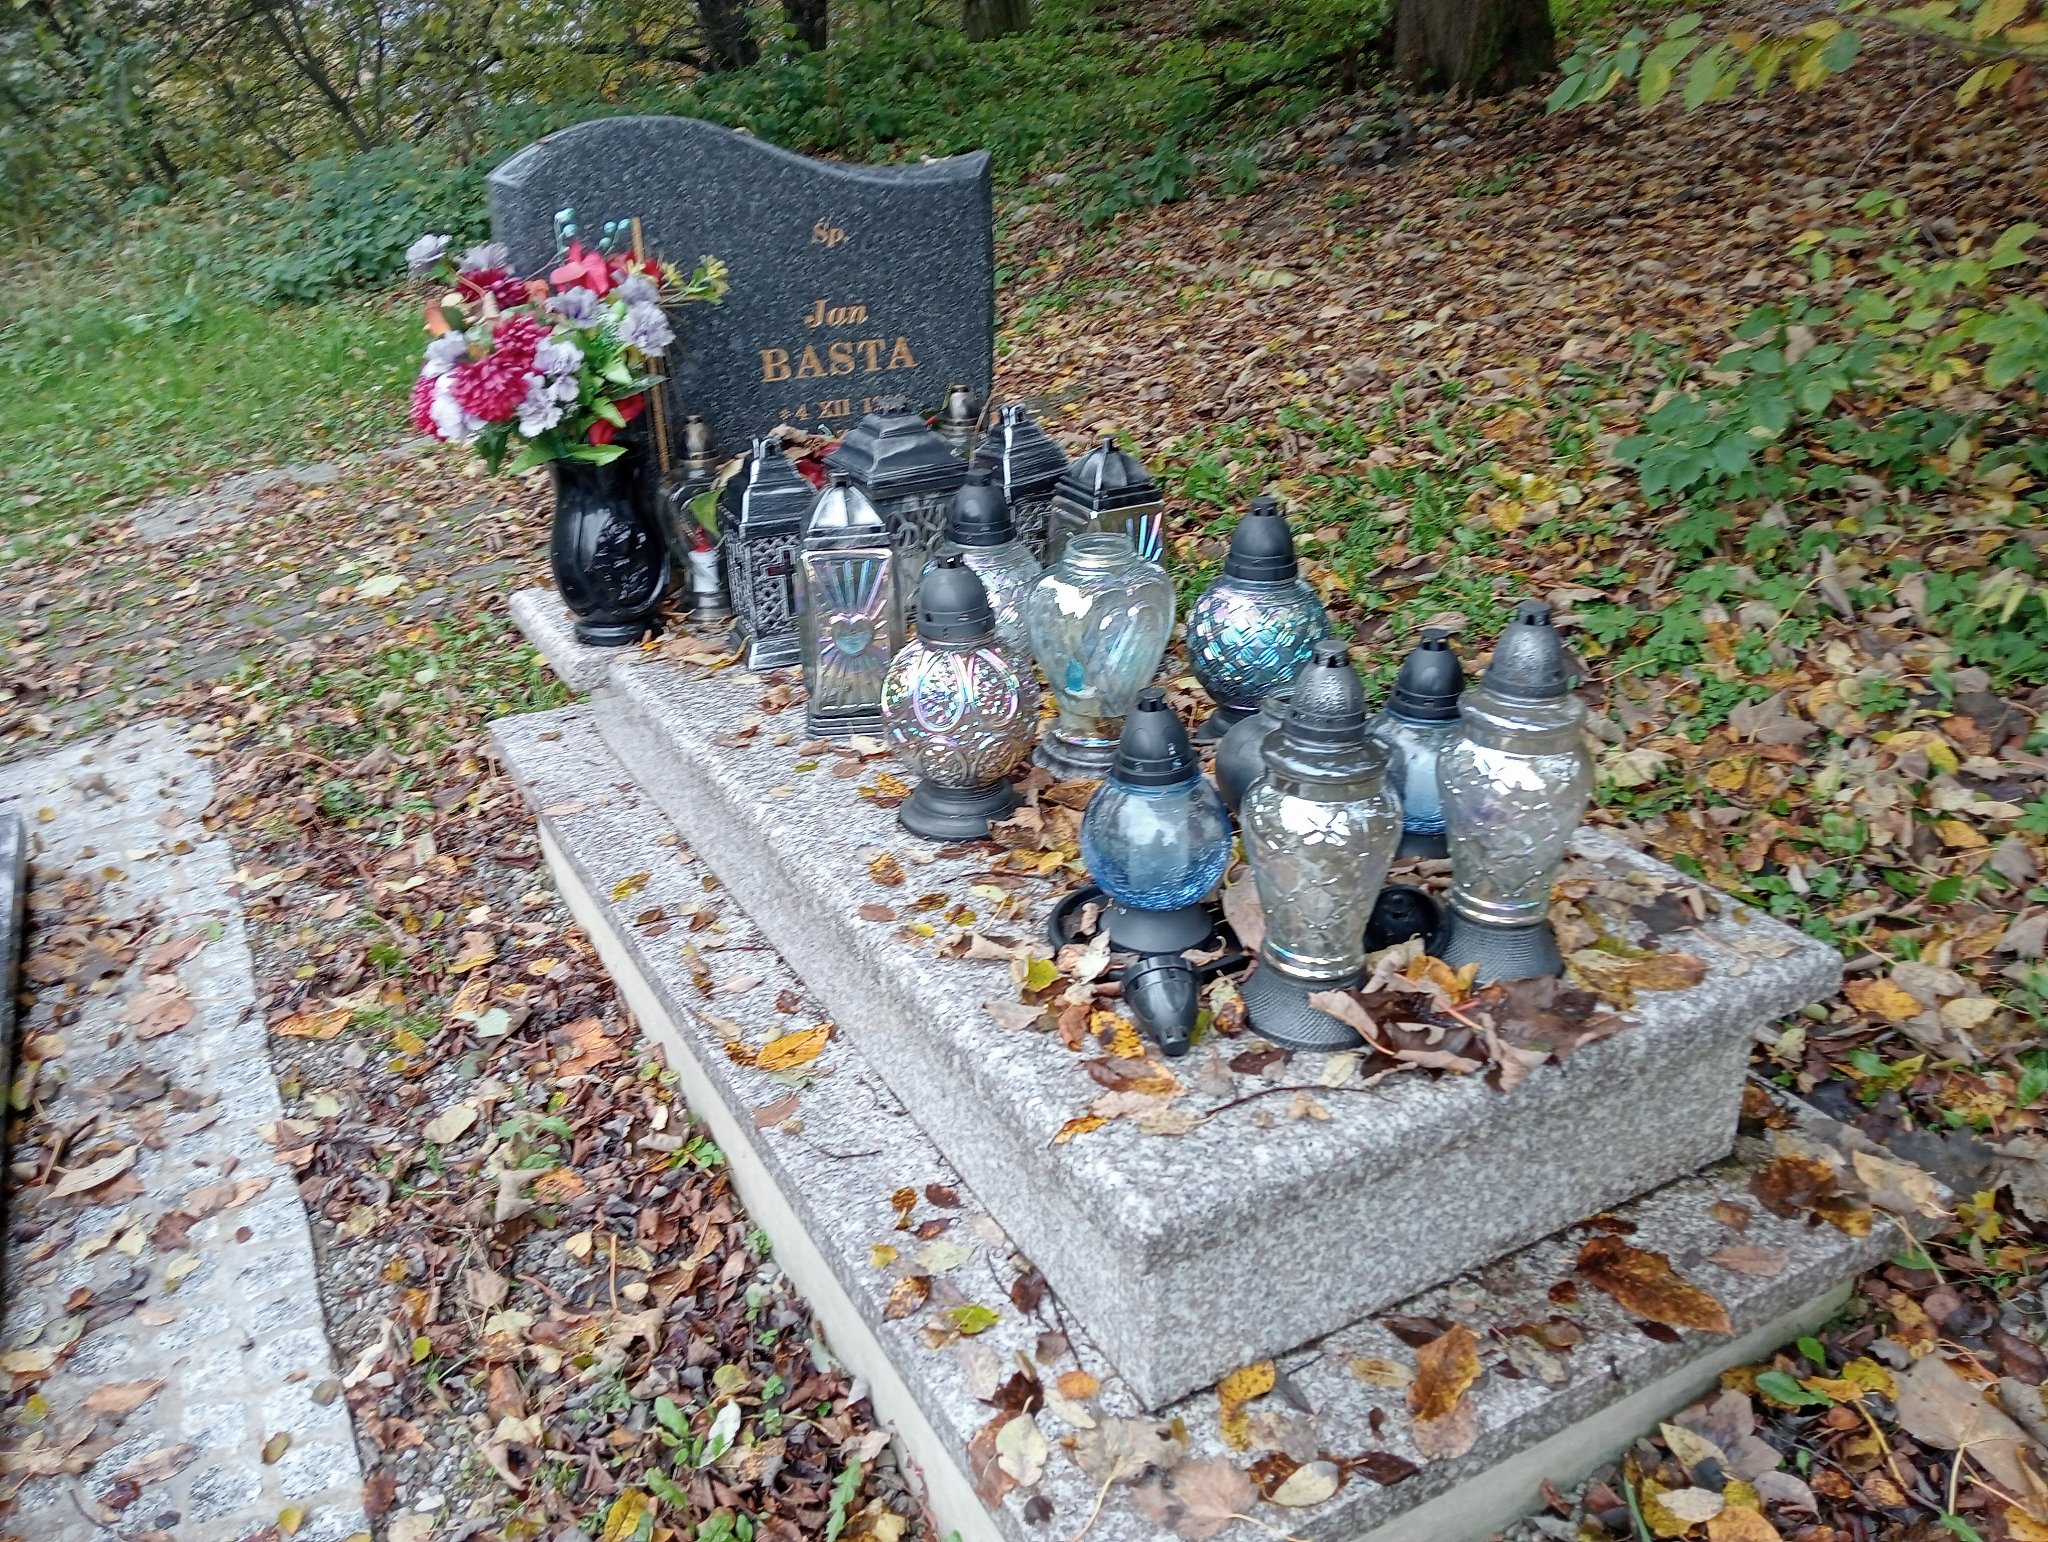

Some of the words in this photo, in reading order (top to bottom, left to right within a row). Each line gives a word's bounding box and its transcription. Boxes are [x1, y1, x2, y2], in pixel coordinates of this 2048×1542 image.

[804, 299, 869, 329] Jan
[760, 336, 919, 383] BASTA
[818, 399, 853, 419] XII
